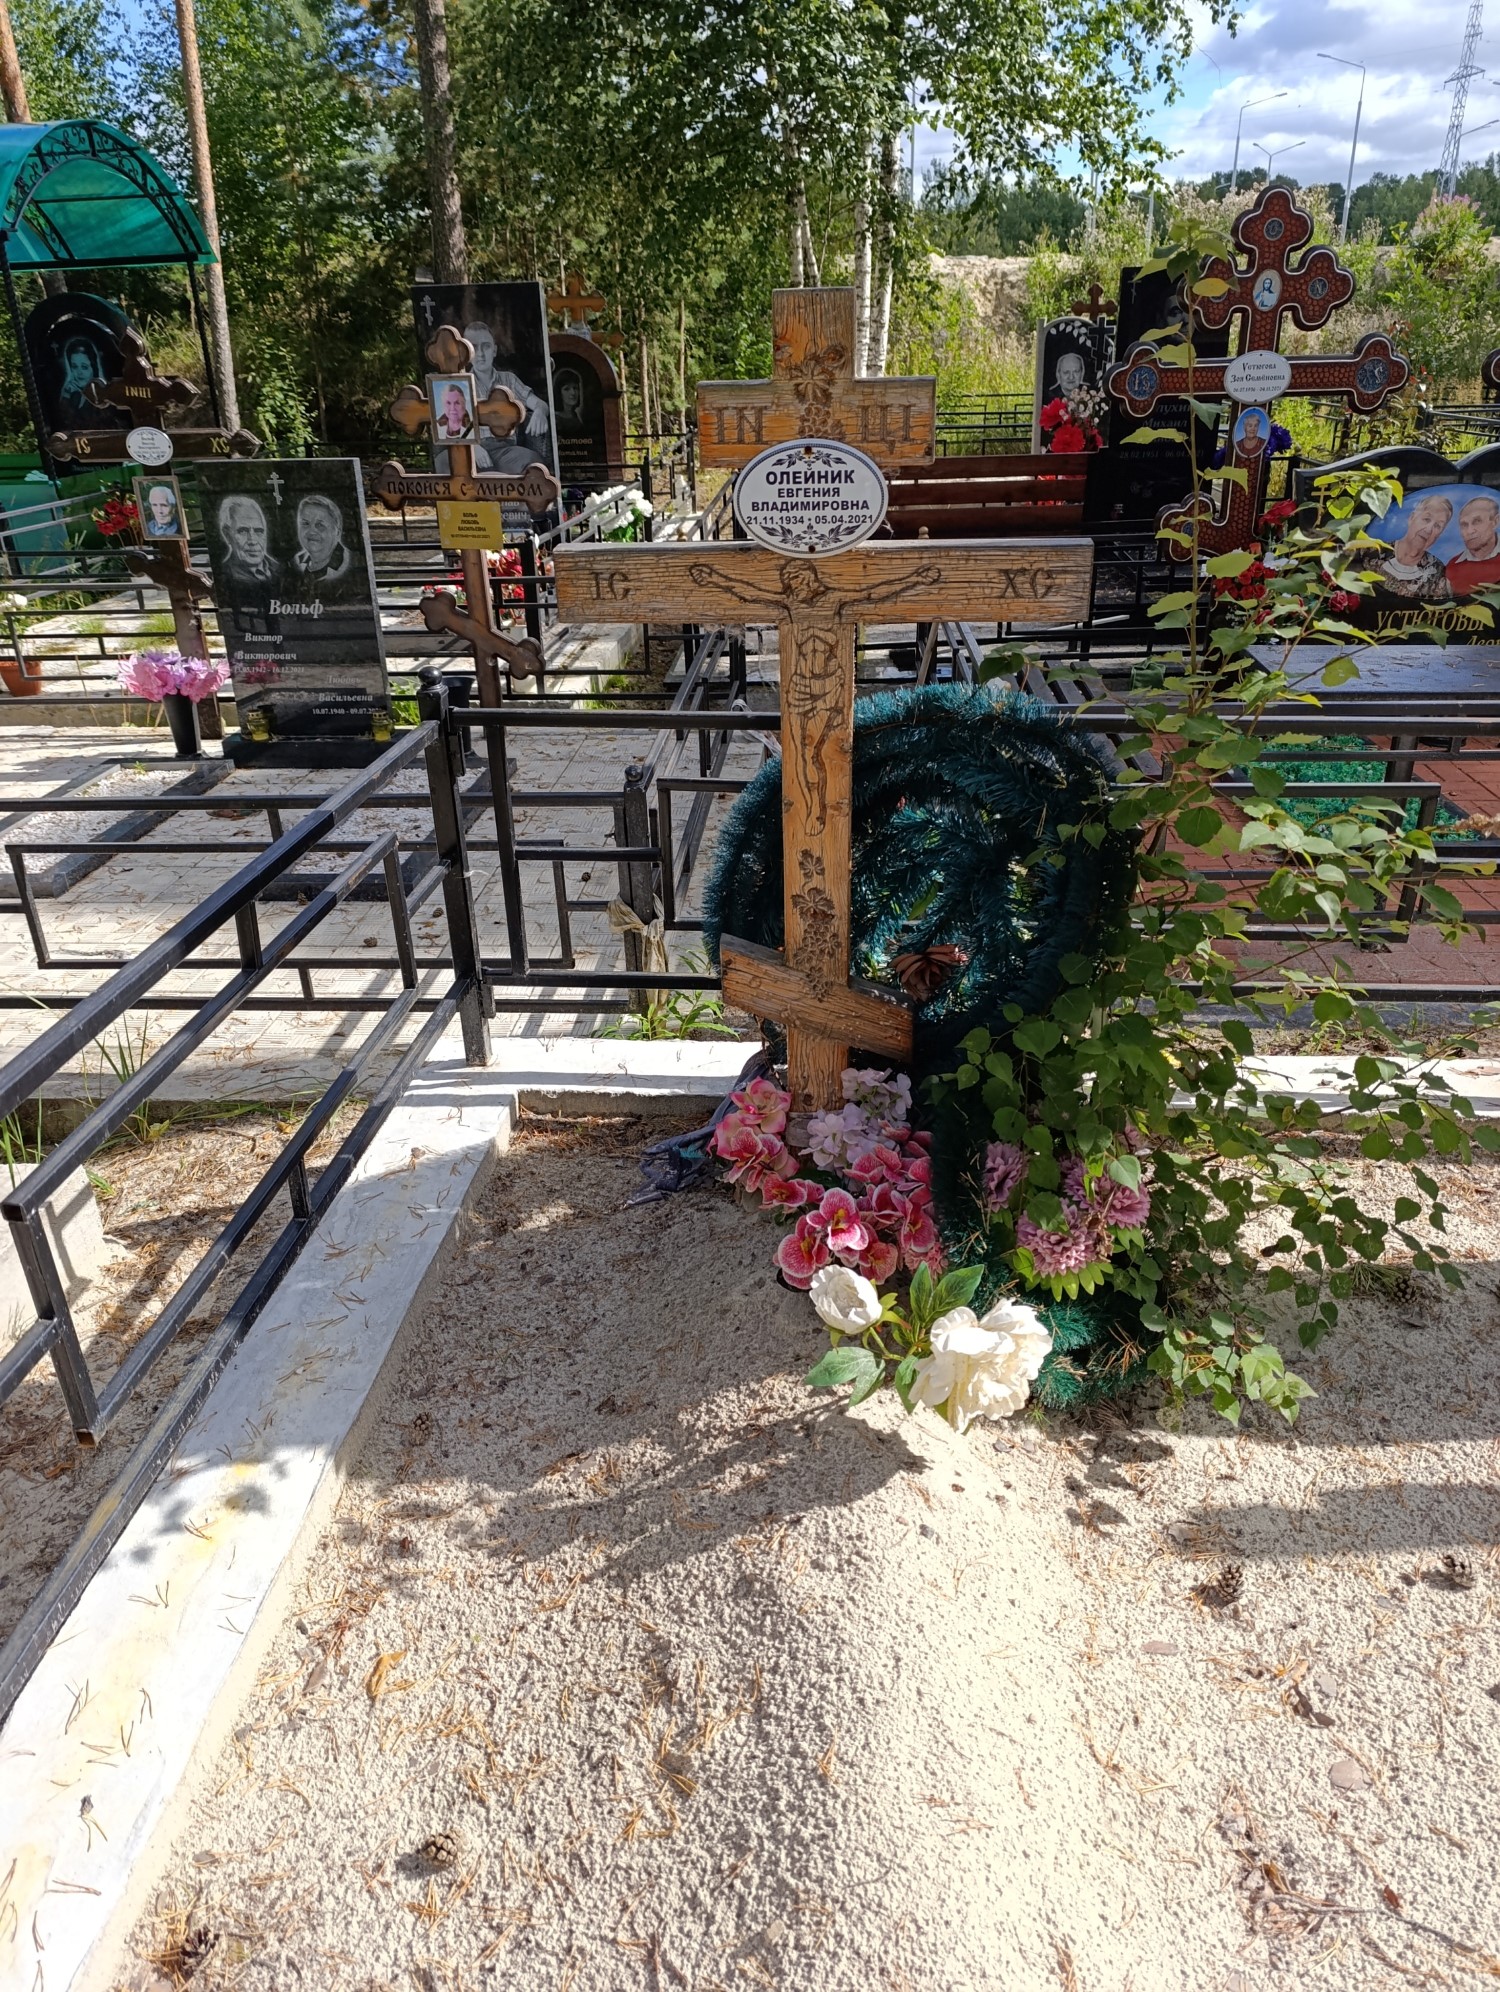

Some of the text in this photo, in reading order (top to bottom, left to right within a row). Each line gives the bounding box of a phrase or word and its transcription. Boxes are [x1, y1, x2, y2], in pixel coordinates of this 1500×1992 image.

[766, 467, 855, 486] ОЛЕЙНИК
[387, 480, 450, 495] ПОКОЙСЯ
[477, 481, 544, 497] МИРОМ
[777, 487, 840, 499] ЕВГЕНИЯ
[751, 499, 870, 513] ВЛАДИМИРОВНА
[746, 515, 805, 525] 21.11.1934
[814, 514, 873, 525] 05.04.2021
[268, 599, 324, 619] Вольф
[244, 632, 283, 644] Виктор
[236, 651, 297, 661] Викторович
[318, 692, 373, 701] Васильевна
